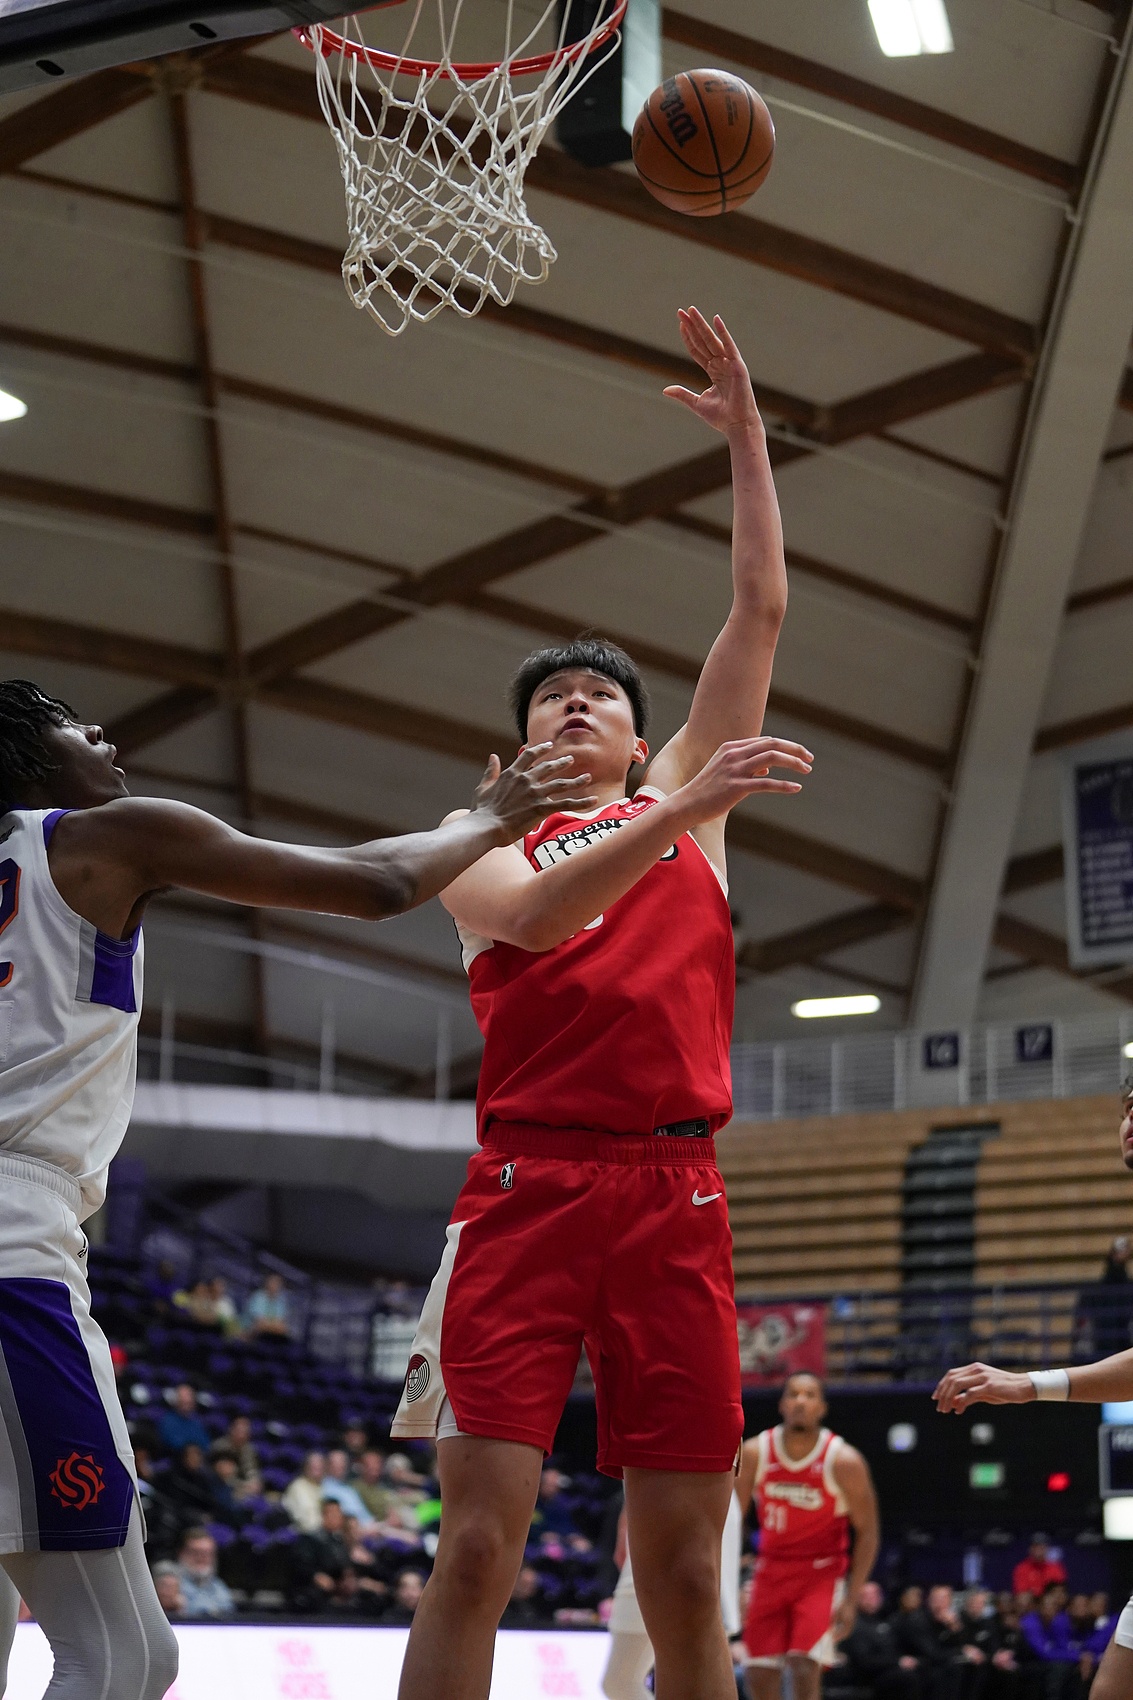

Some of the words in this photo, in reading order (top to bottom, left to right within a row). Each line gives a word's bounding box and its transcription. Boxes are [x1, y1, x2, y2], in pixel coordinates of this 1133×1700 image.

[661, 77, 698, 147] Wil
[533, 819, 677, 870] Rem
[557, 831, 582, 842] RIP
[584, 819, 616, 834] CITY
